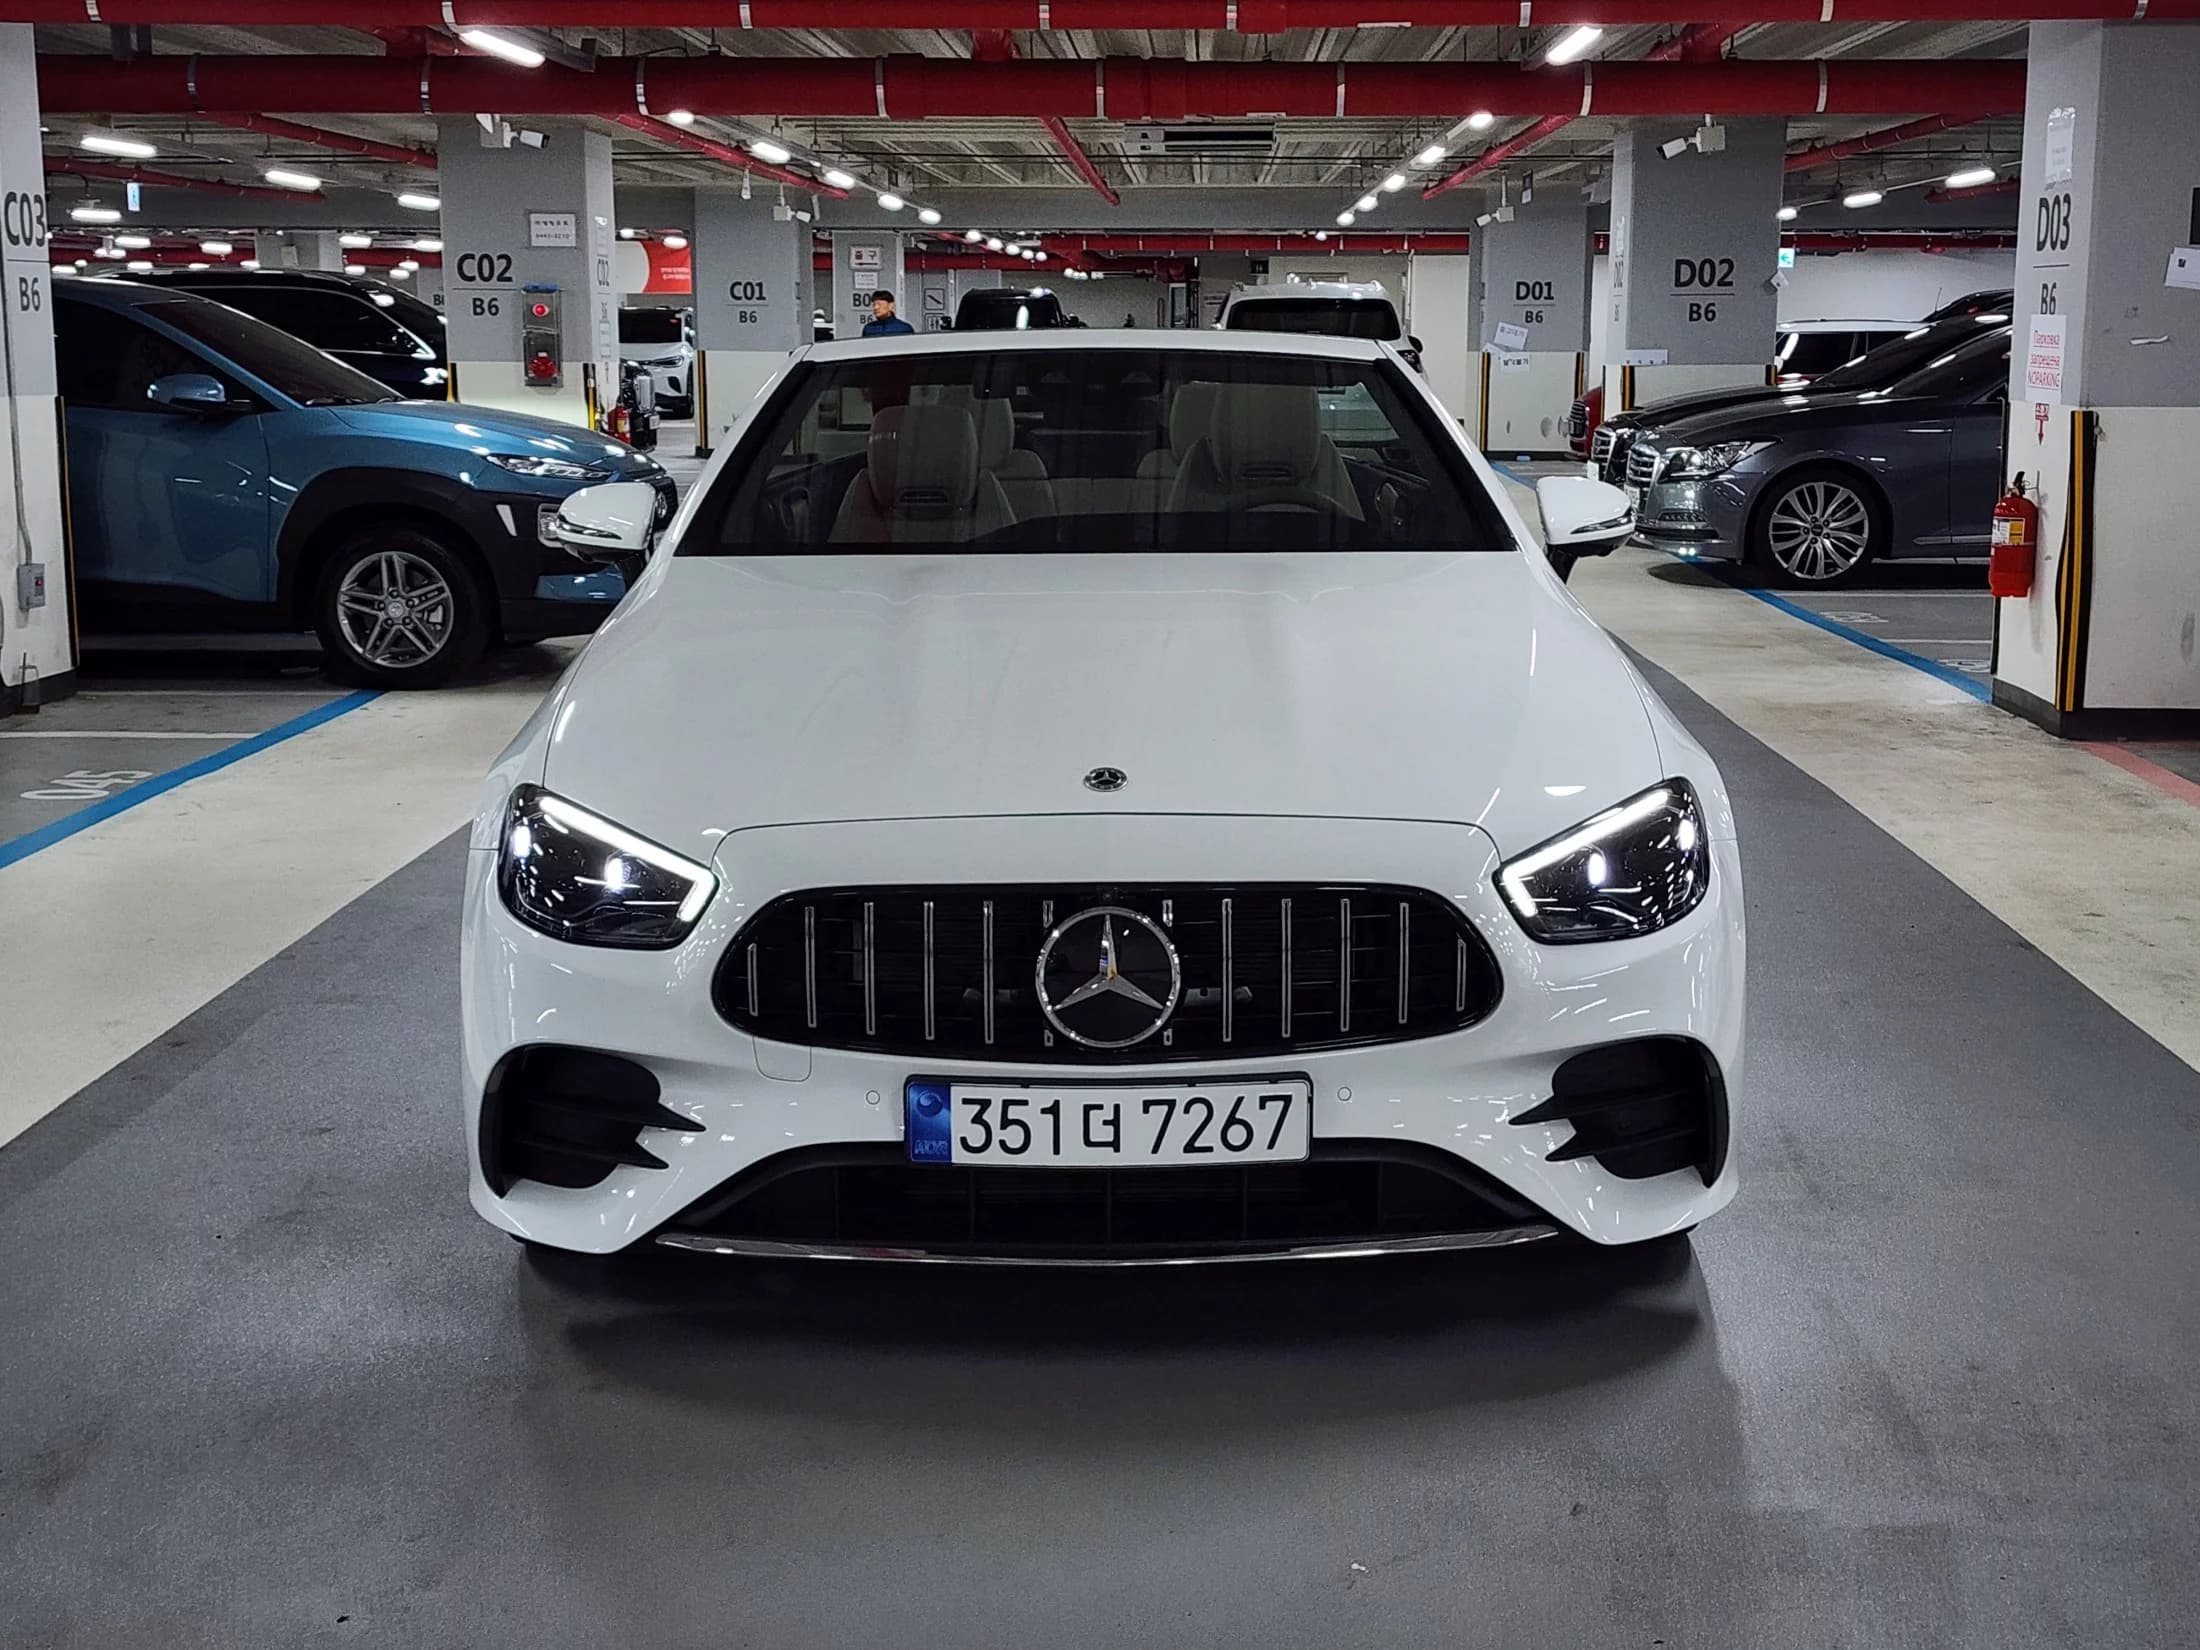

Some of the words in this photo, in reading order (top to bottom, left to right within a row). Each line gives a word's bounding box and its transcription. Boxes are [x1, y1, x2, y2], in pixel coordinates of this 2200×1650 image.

[4, 191, 46, 247] C03
[2036, 193, 2071, 252] D03
[457, 253, 513, 282] C02
[1674, 258, 1735, 288] D02
[19, 277, 41, 311] B6
[433, 294, 445, 306] B
[730, 281, 767, 301] C01
[853, 293, 872, 308] B0
[1515, 281, 1555, 300] D01
[2040, 282, 2057, 315] B6
[472, 298, 500, 316] B6
[739, 310, 757, 324] B6
[1525, 310, 1544, 323] B6
[1688, 302, 1717, 322] B6
